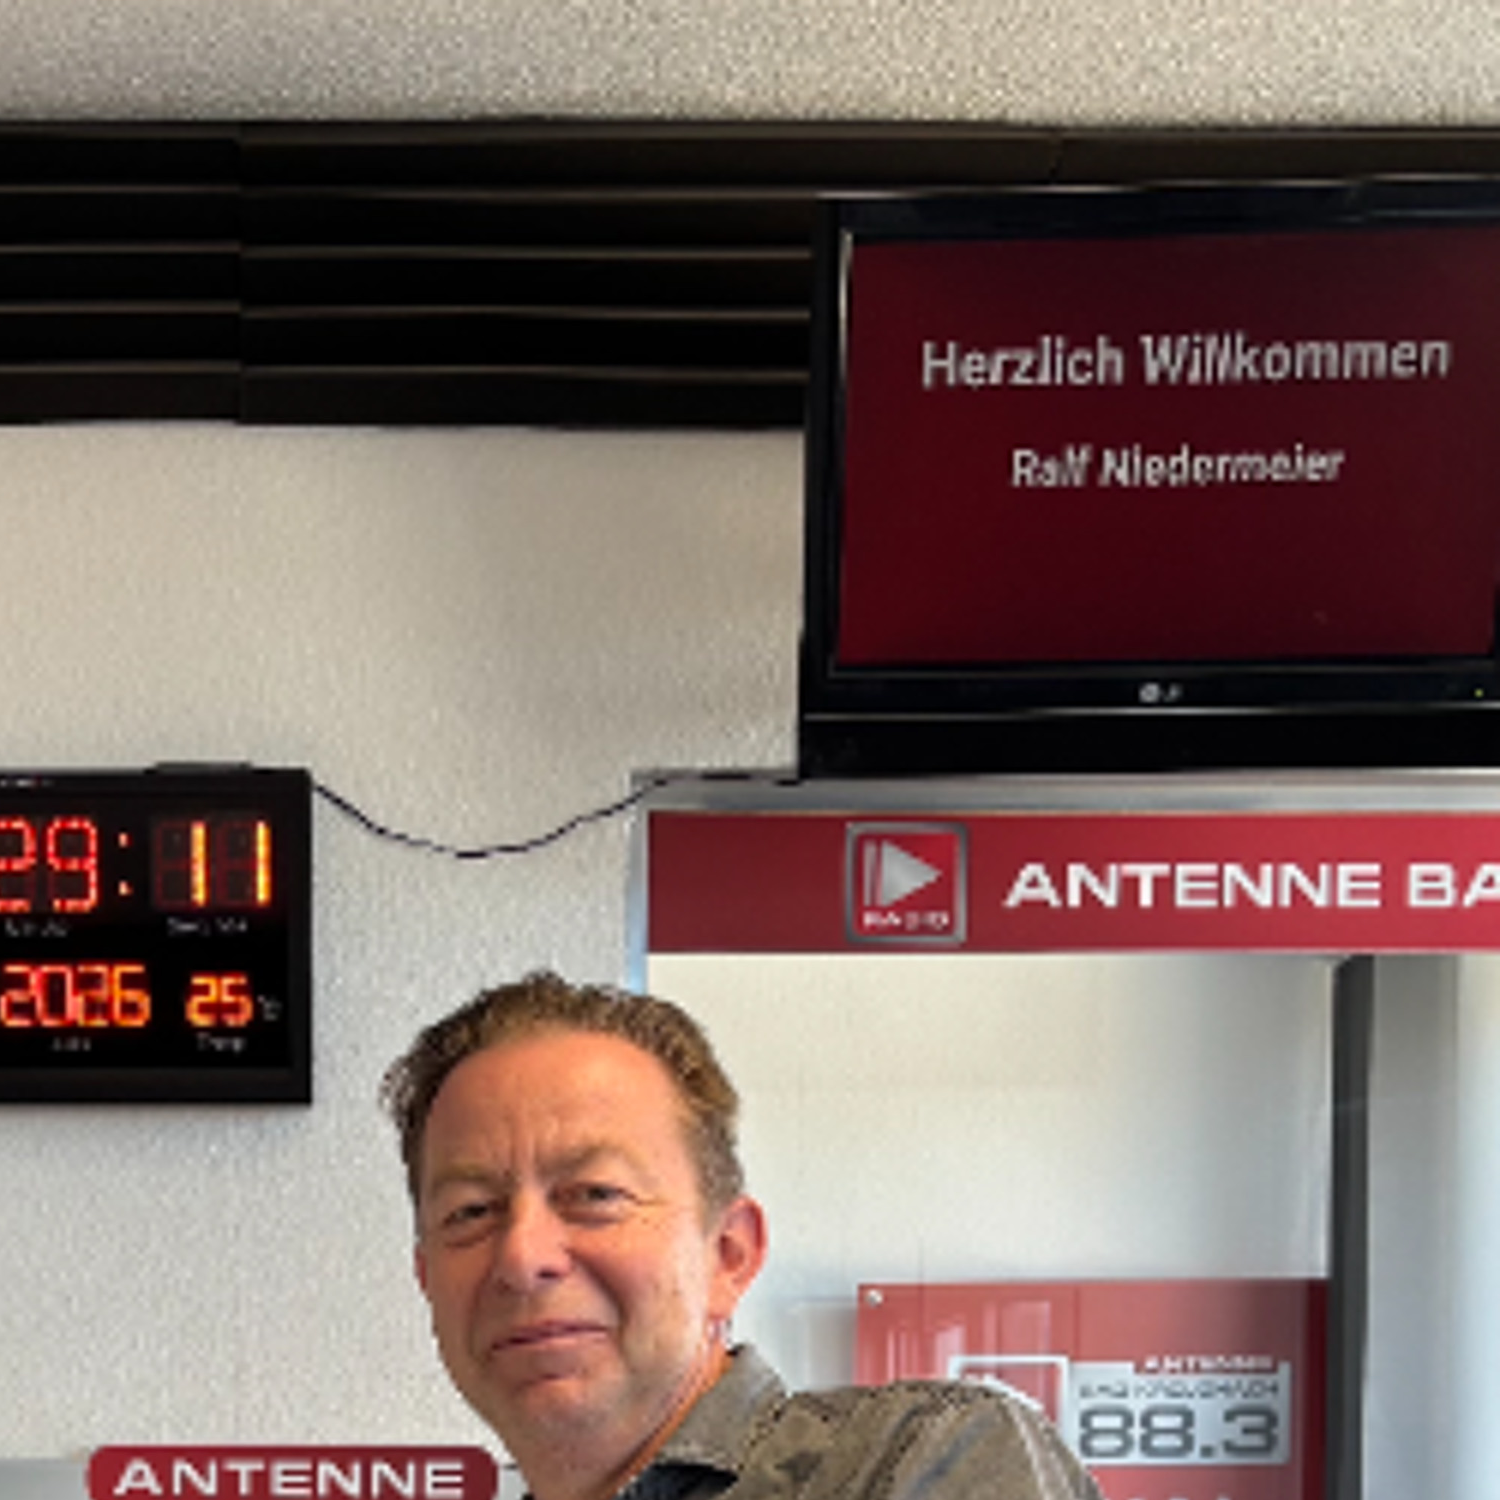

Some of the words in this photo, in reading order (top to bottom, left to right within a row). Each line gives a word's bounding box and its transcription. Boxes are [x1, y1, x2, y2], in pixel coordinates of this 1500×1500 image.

[922, 335, 1124, 388] Herzlich
[1140, 333, 1449, 384] Willkommen
[1012, 446, 1091, 487] Ralf
[1099, 443, 1345, 487] Niedermeier
[1004, 863, 1381, 908] ANTENNE
[0, 963, 152, 1028] 2026
[185, 974, 254, 1028] 25
[1079, 1405, 1280, 1459] 88.3
[113, 1458, 465, 1500] ANTENNE
